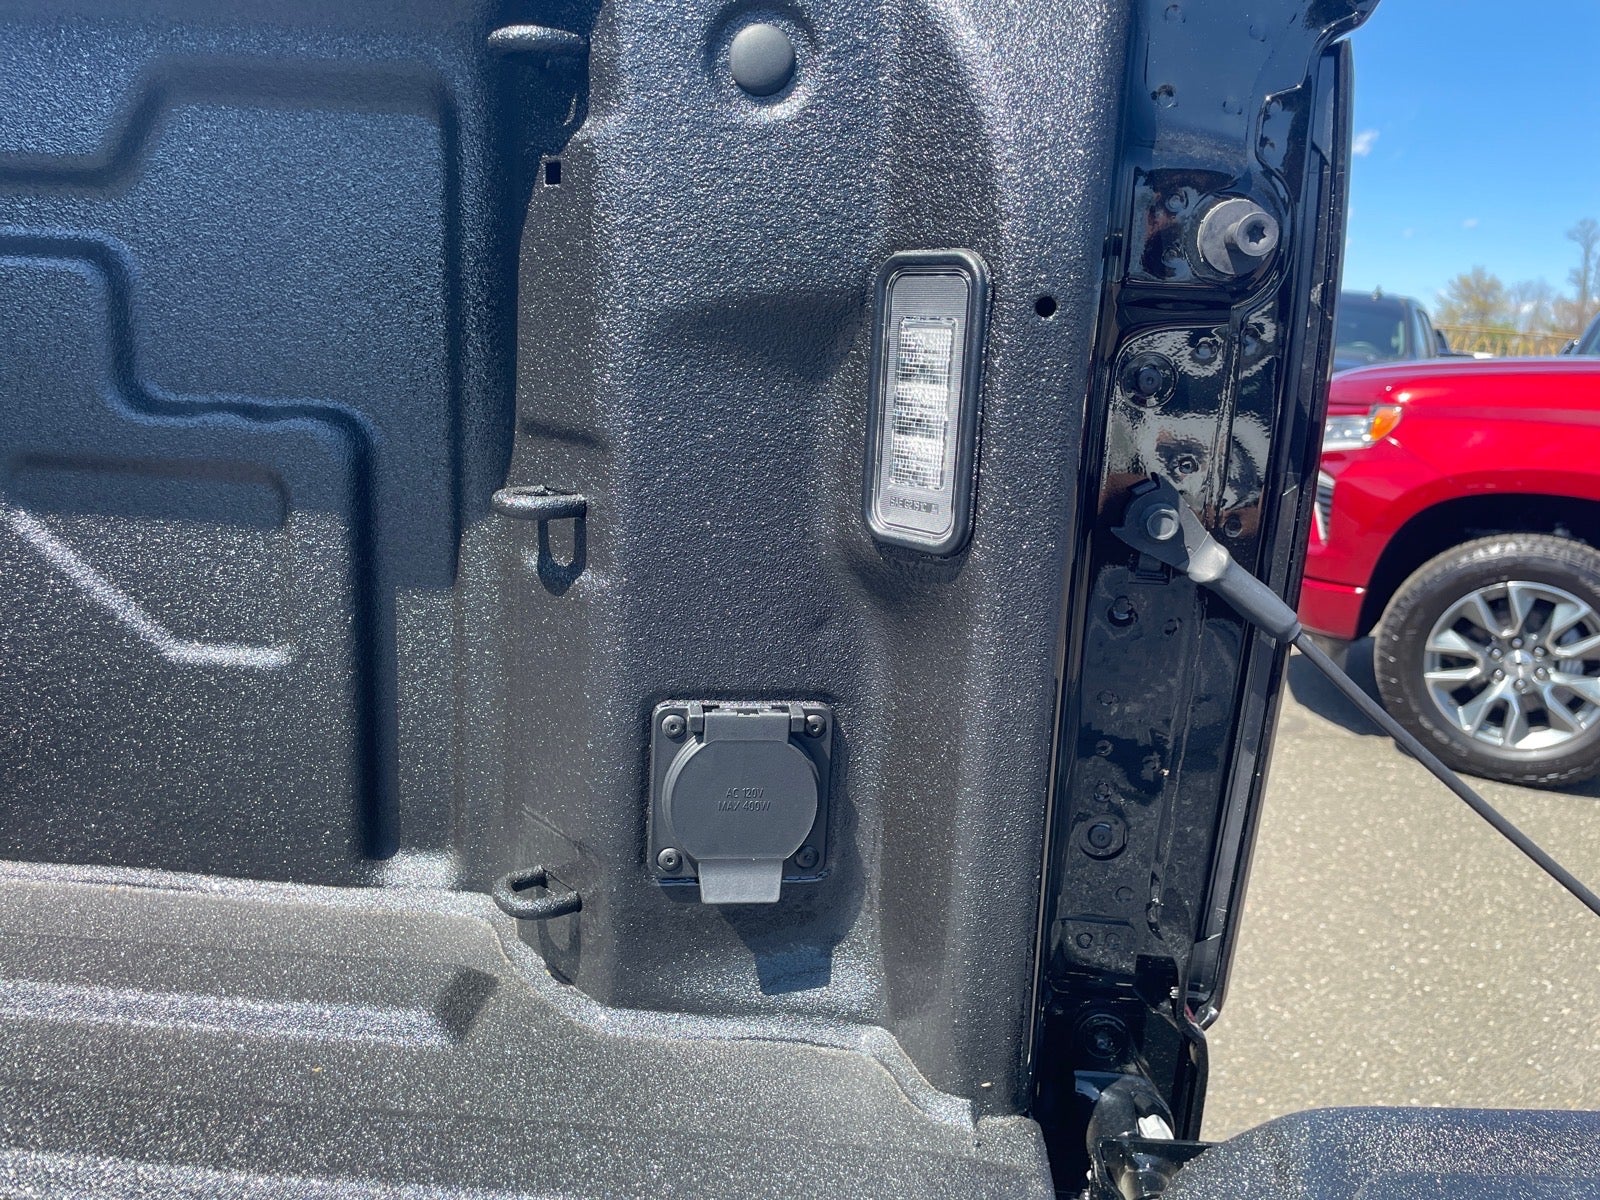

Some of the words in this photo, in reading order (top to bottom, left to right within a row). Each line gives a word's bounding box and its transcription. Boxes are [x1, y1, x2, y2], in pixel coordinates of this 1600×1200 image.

[726, 787, 739, 798] AC
[742, 787, 764, 798] 120V
[718, 800, 740, 812] MAX
[742, 800, 771, 812] 400W
